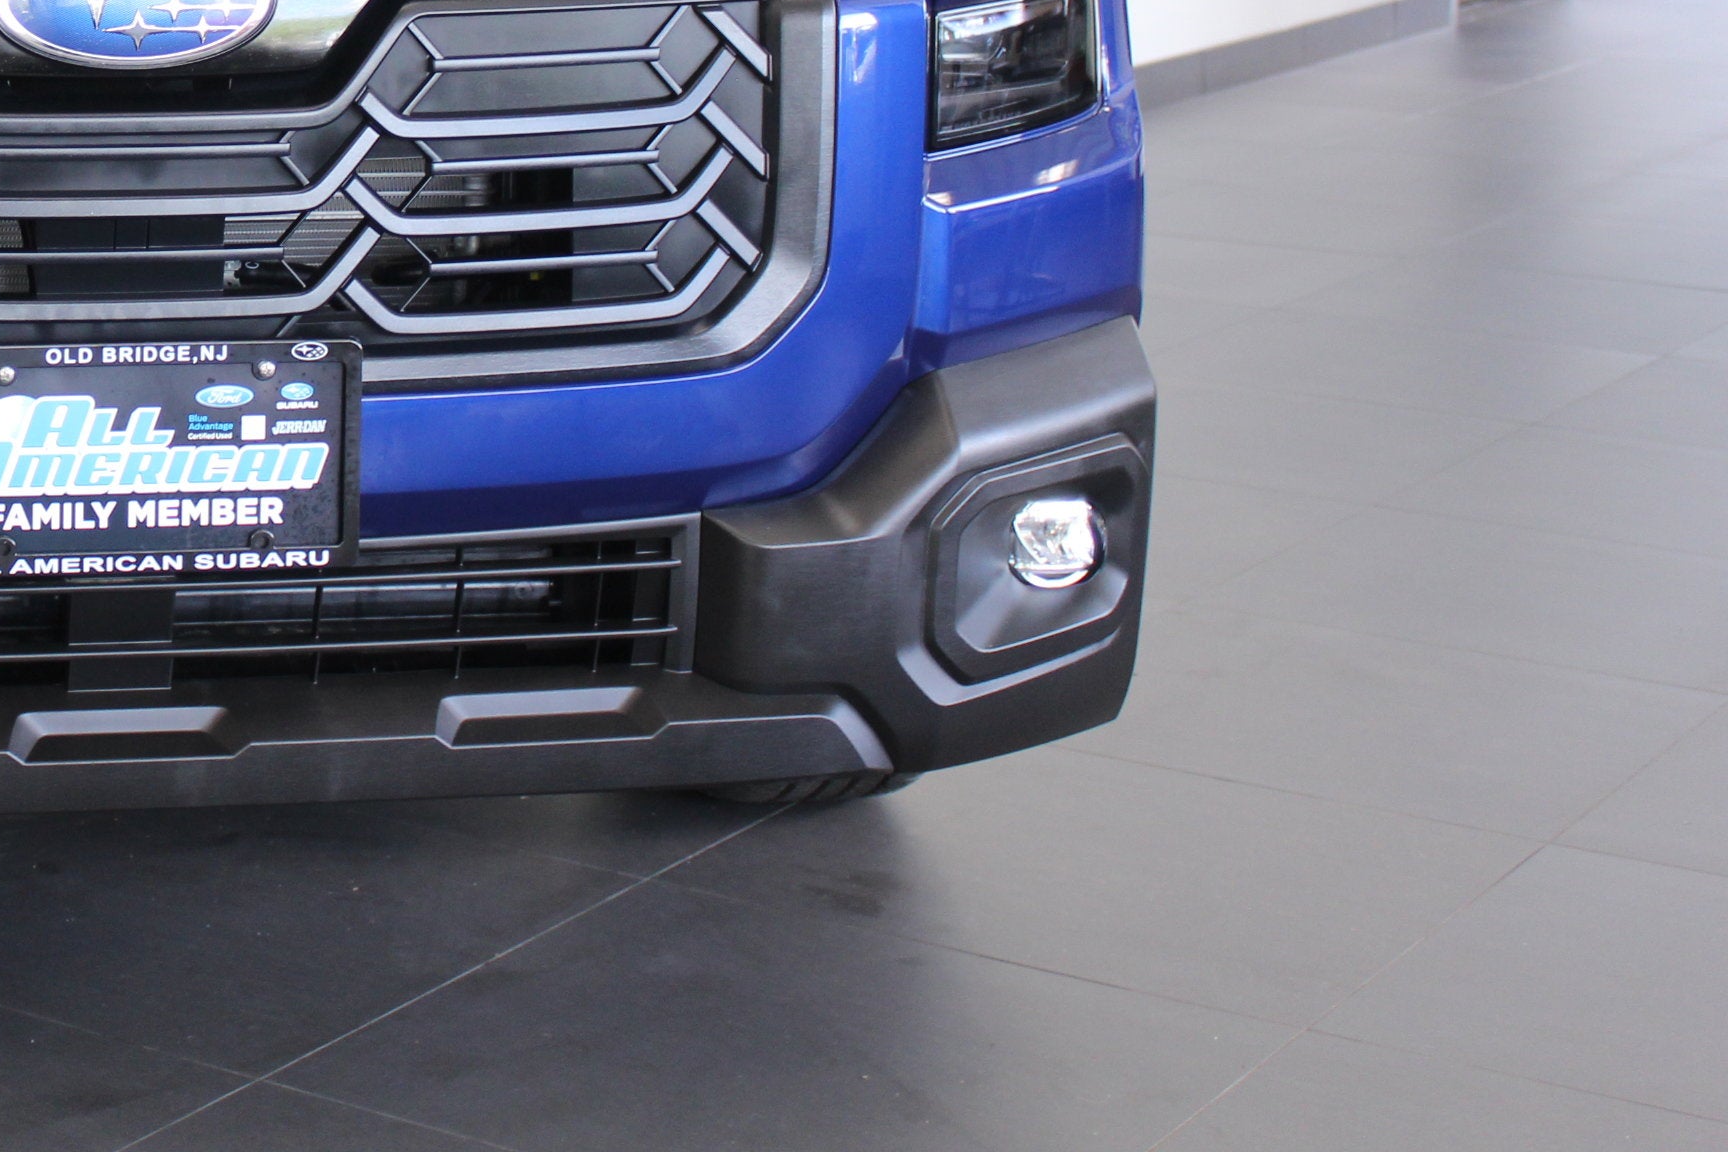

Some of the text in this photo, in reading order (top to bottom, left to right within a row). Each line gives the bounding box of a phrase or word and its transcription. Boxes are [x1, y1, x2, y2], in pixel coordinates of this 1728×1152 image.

[45, 347, 94, 365] OLD
[275, 400, 320, 411] SUBARU
[188, 414, 209, 423] Blue
[188, 422, 234, 432] Advantage
[187, 432, 233, 440] Certified Used
[126, 497, 284, 529] MEMBER
[9, 553, 184, 575] AMERICAN
[193, 550, 330, 571] SUBARU
